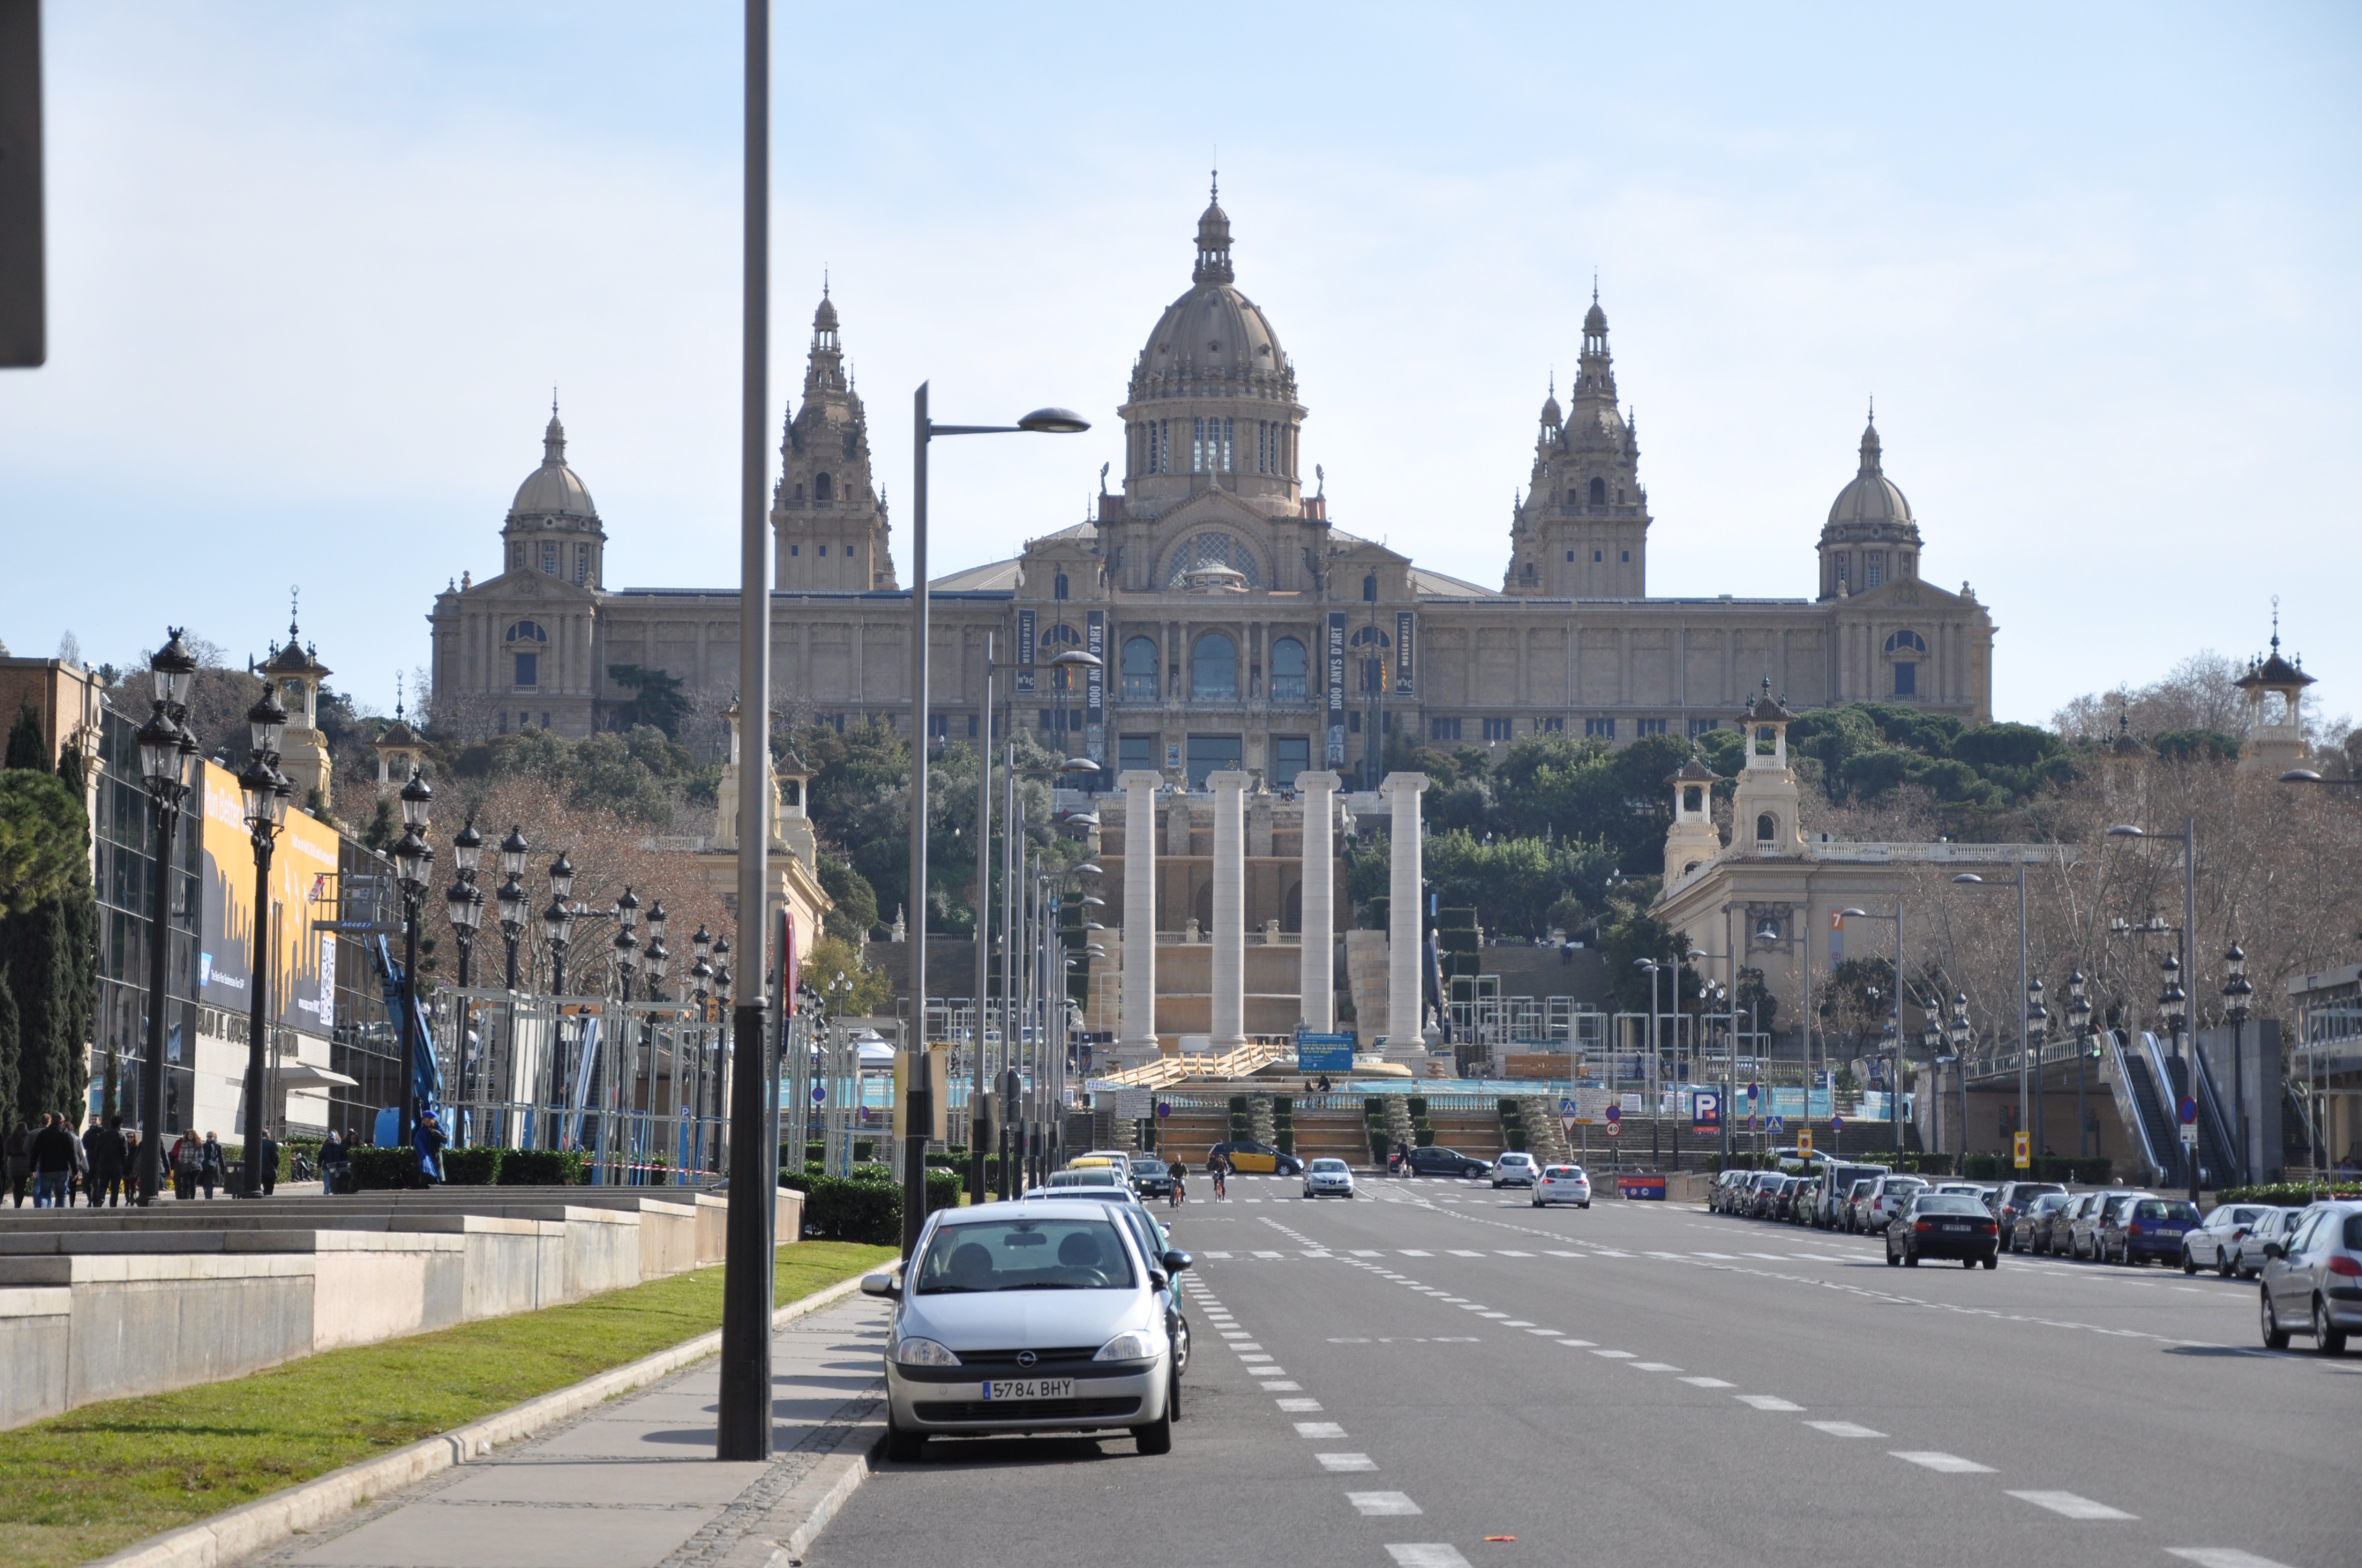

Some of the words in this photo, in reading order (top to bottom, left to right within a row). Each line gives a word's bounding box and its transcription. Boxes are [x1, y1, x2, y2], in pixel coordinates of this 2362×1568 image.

[1089, 625, 1101, 653] D'ART
[1331, 626, 1342, 654] D'ART
[1331, 659, 1342, 683] ANYS
[1089, 685, 1101, 709] 1000
[1331, 688, 1342, 710] 1000
[205, 779, 218, 819] Run
[219, 786, 240, 830] Better
[682, 1107, 689, 1117] P
[1696, 1094, 1716, 1119] P
[993, 1382, 1034, 1397] 5784
[1040, 1380, 1071, 1396] BHY
